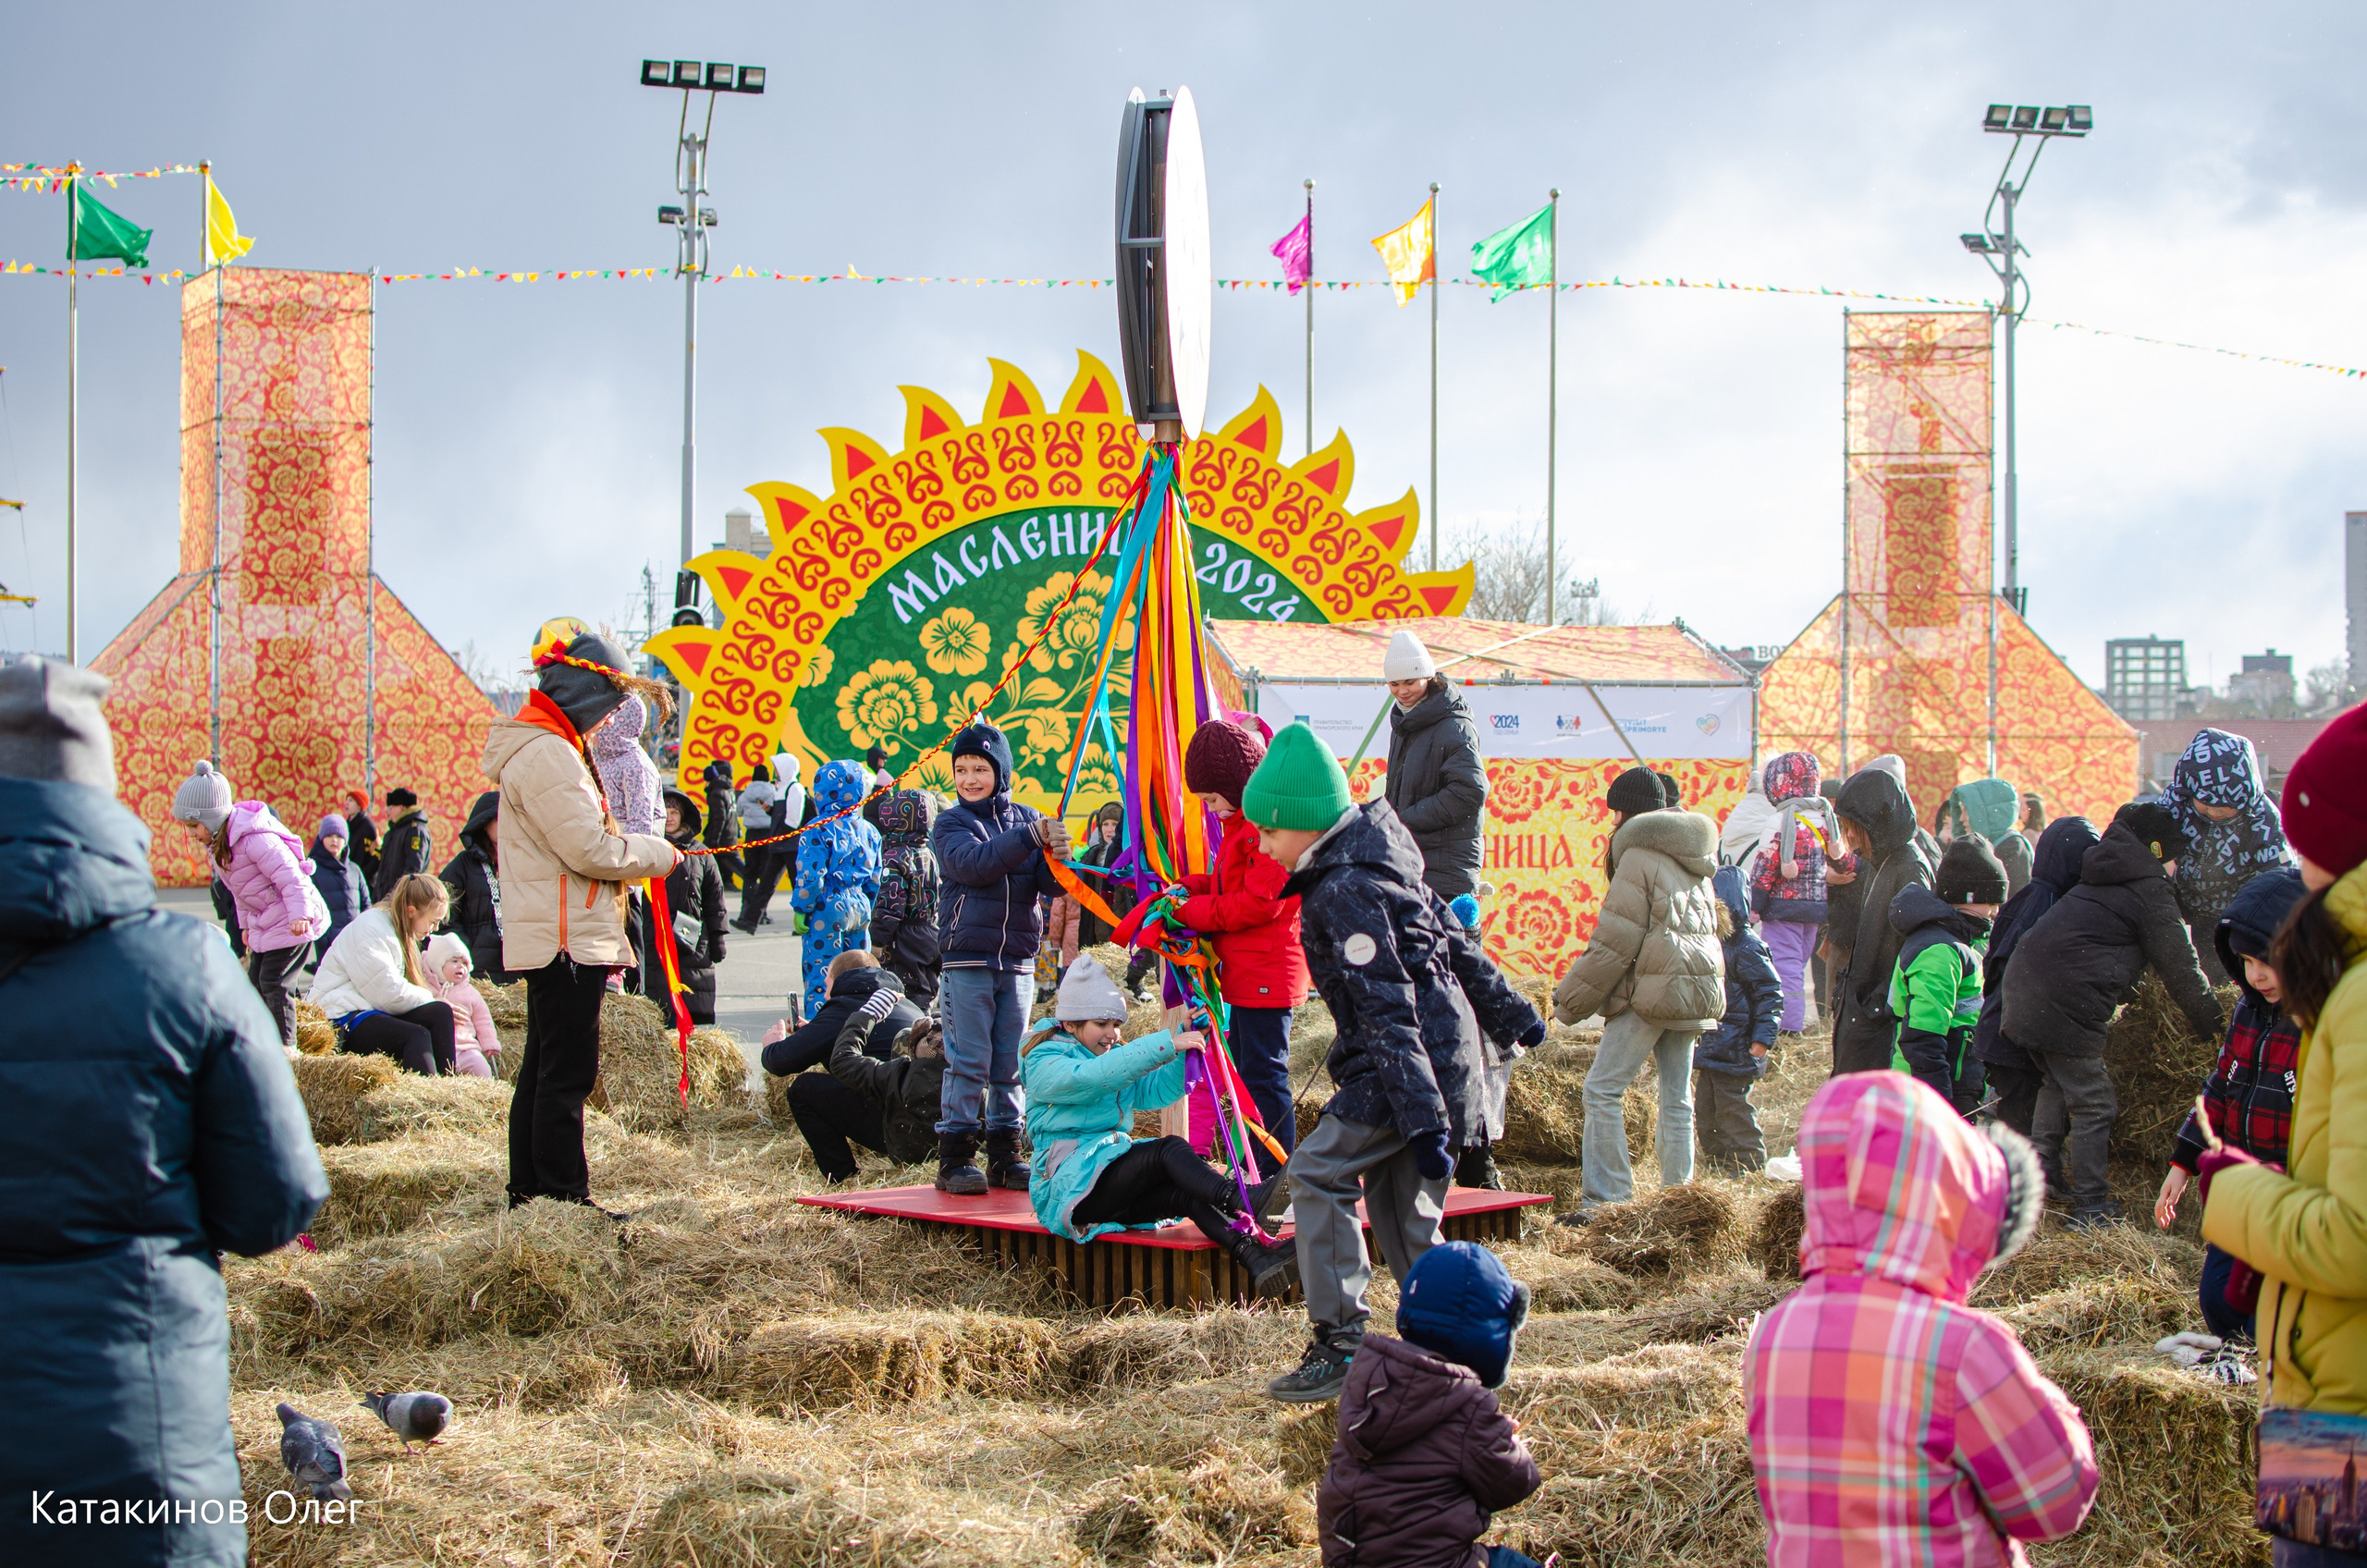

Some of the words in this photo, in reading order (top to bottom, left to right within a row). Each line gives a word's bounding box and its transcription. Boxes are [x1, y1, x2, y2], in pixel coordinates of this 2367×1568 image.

[886, 511, 1132, 624] МАСЛЕНИ
[1196, 543, 1300, 622] 2024
[1494, 715, 1519, 729] 2024
